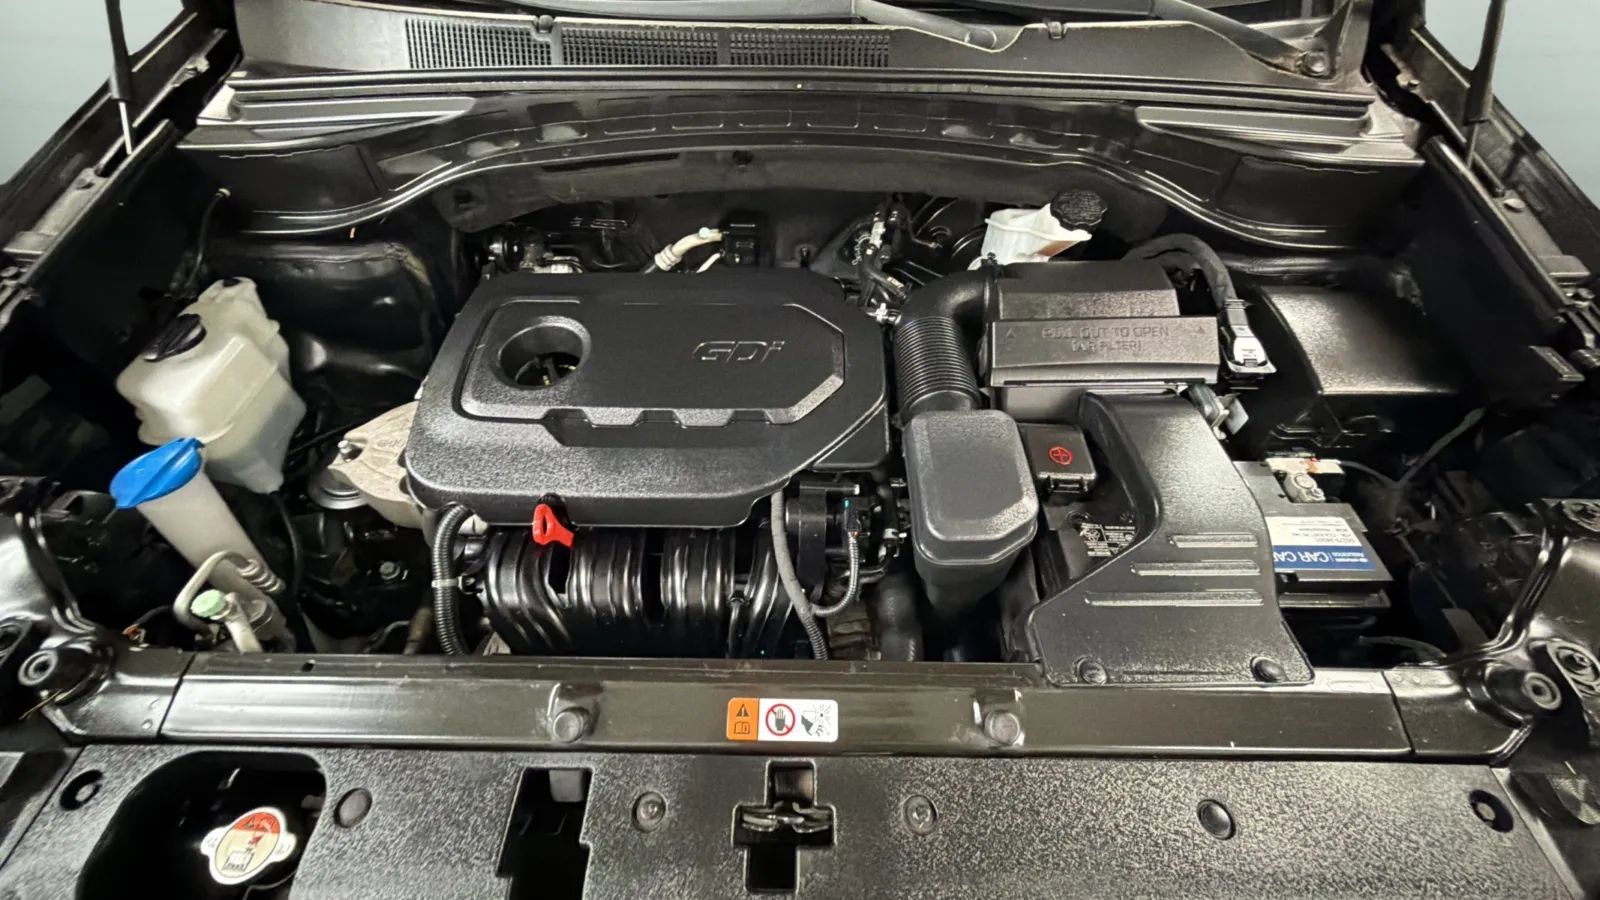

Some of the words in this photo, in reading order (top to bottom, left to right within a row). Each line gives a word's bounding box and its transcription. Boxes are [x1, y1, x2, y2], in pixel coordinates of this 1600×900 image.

[1042, 327, 1078, 340] PULL
[1080, 326, 1109, 339] OUT
[1112, 326, 1131, 338] TO
[1132, 326, 1170, 338] OPEN
[691, 340, 785, 363] GDi
[1297, 551, 1330, 563] CAR
